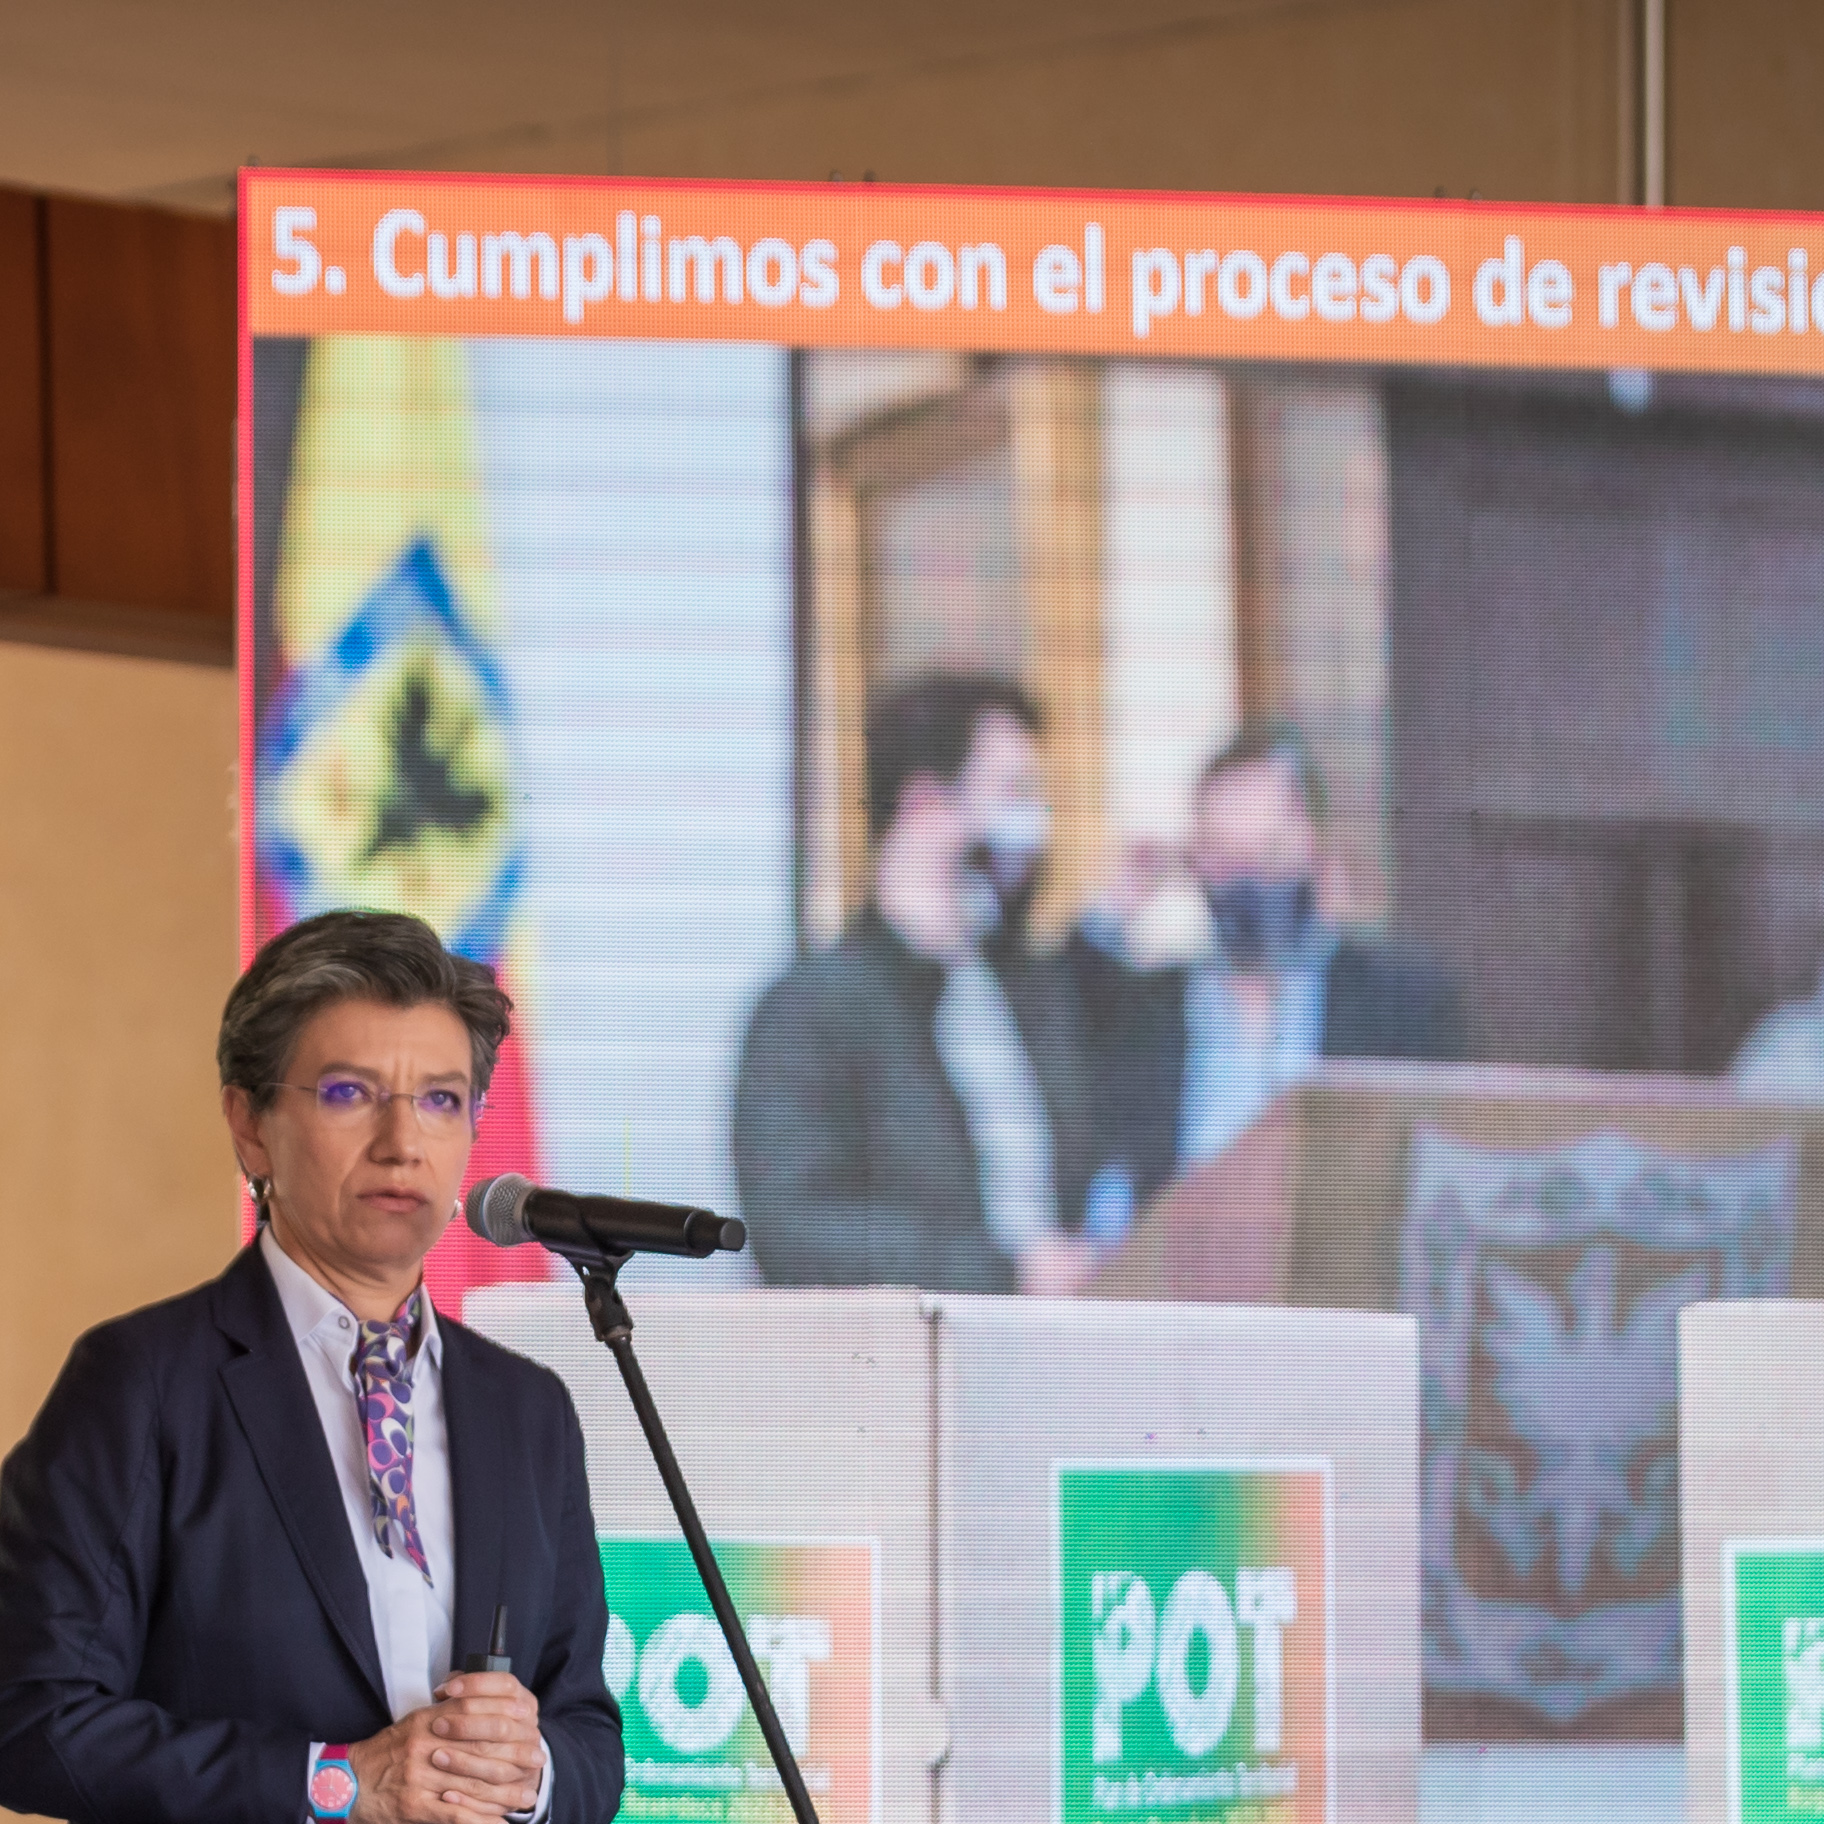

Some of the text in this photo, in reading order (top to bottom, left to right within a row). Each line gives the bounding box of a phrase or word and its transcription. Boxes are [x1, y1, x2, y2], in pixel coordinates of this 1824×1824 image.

[269, 206, 347, 296] 5.
[370, 208, 842, 324] Cumplimos
[859, 239, 1010, 313] con
[1030, 221, 1107, 316] el
[1129, 240, 1453, 339] proceso
[1471, 235, 1576, 330] de
[1091, 1567, 1298, 1765] POT
